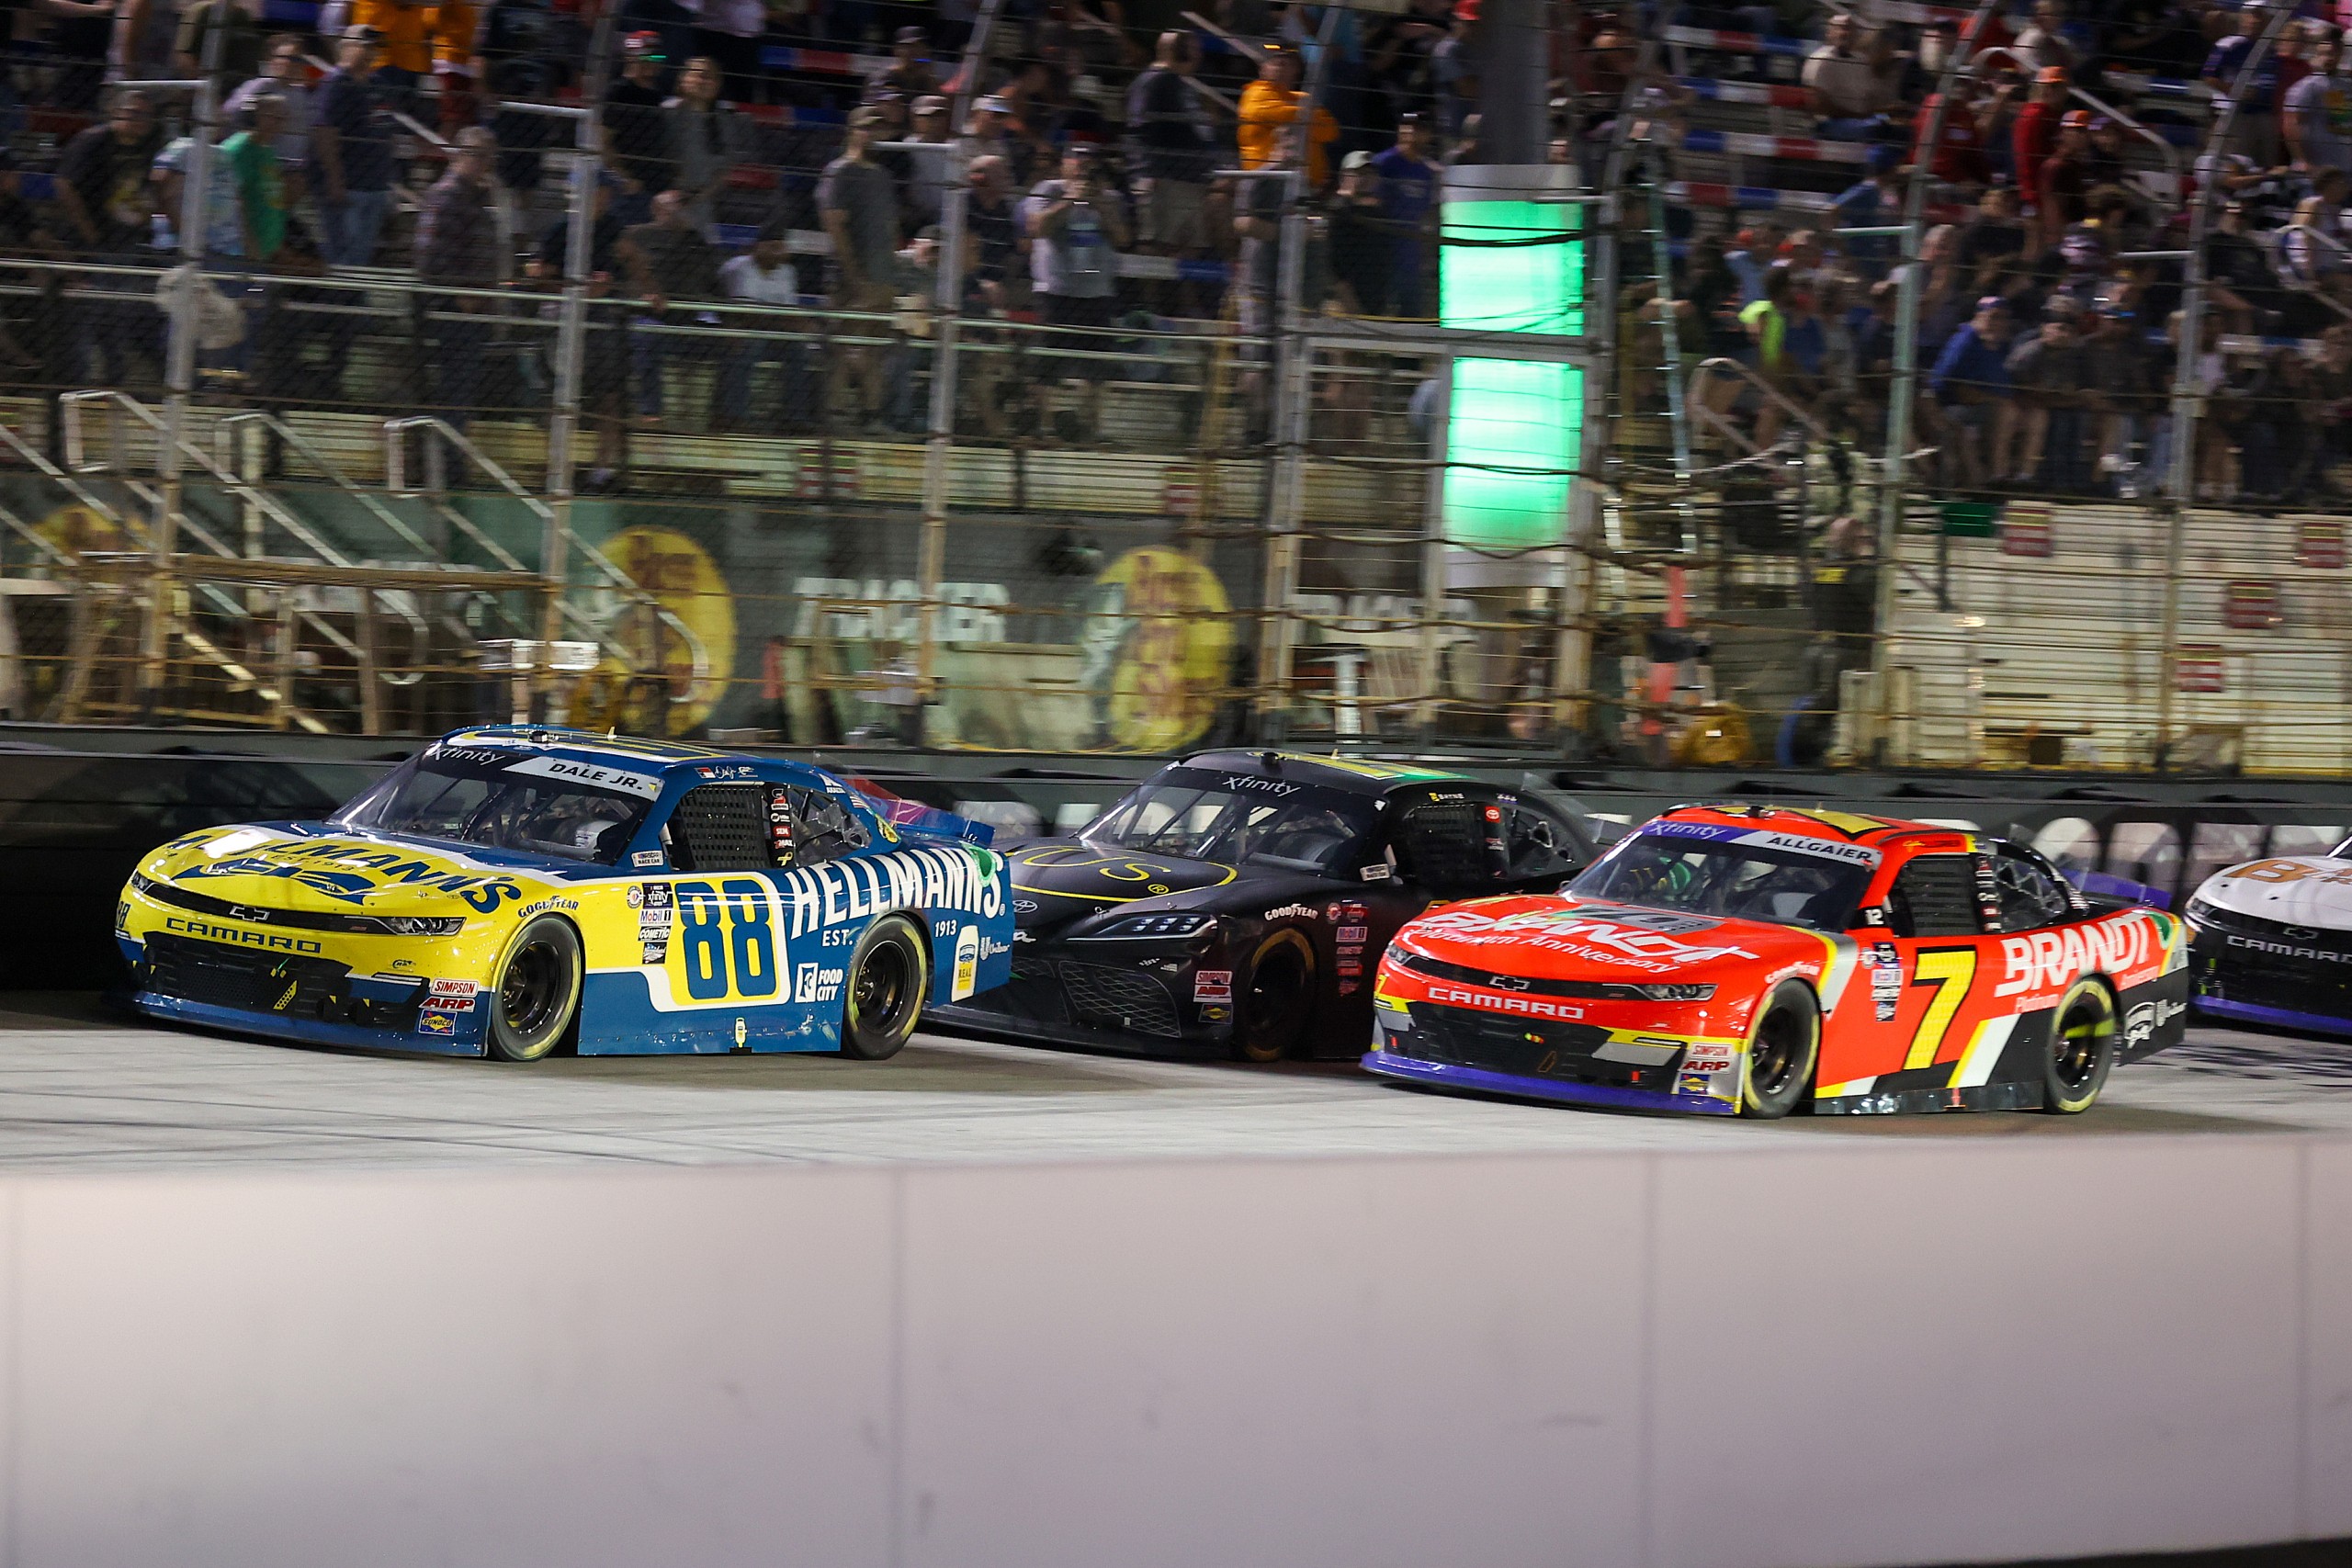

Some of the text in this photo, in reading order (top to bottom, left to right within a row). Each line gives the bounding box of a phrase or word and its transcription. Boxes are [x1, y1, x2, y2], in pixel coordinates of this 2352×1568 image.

[428, 746, 505, 765] xfinity
[548, 763, 642, 790] DALE JR.
[1222, 775, 1301, 796] xfinity
[1648, 822, 1728, 840] xfinity
[1766, 837, 1871, 862] ALLGAIER
[165, 833, 522, 914] HLLMANN'S
[785, 848, 1003, 941] HELLMANNS
[518, 896, 579, 918] GOODYEAR
[640, 909, 672, 922] Mobil 1
[1264, 903, 1318, 920] GOODYEAR
[1865, 908, 1884, 925] 12
[166, 917, 322, 953] CAMARO
[822, 929, 854, 947] EST.
[934, 919, 957, 938] 1913
[674, 879, 776, 999] 88
[1528, 934, 1680, 974] Anniversary
[1994, 912, 2150, 998] BRANDT
[818, 968, 842, 985] FOOD
[958, 968, 971, 978] REAL
[435, 981, 475, 994] SIMPSON
[817, 985, 838, 1002] CITY
[423, 998, 474, 1010] ARP
[1428, 987, 1584, 1019] CAMARO
[1902, 946, 1977, 1070] 7
[423, 1019, 453, 1027] SUNOCO
[1682, 1061, 1729, 1070] ARP
